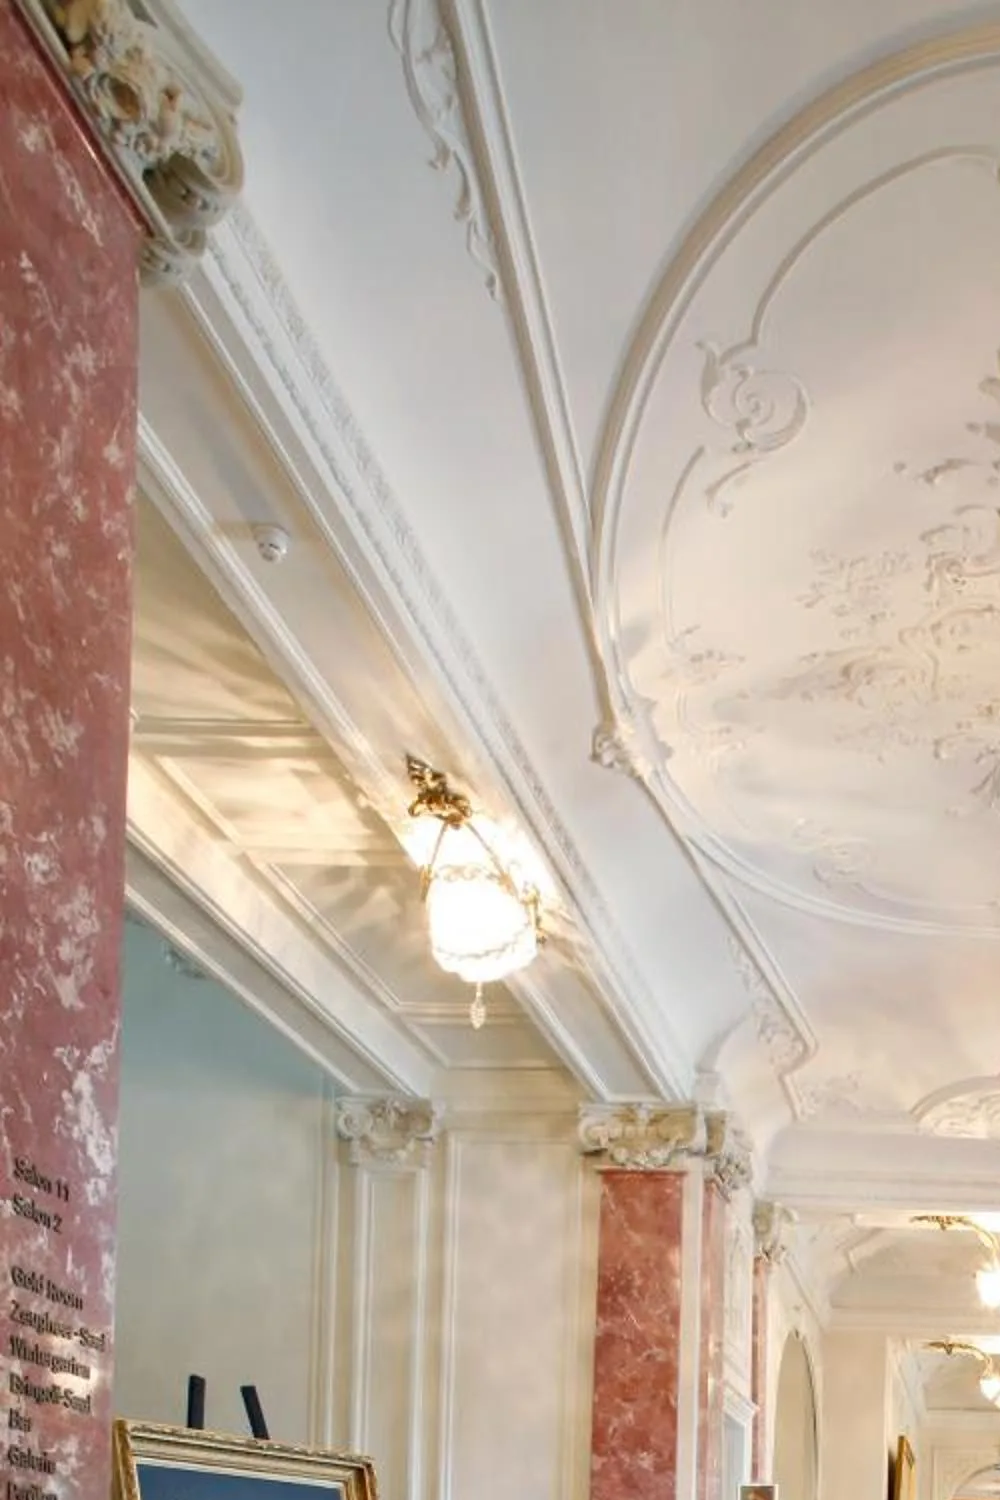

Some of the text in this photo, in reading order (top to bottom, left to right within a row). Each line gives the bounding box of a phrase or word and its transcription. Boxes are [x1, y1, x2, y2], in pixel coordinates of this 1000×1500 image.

[13, 1155, 52, 1194] Salon
[12, 1193, 63, 1235] Salon 2
[9, 1334, 91, 1380] Wintergarten
[7, 1407, 32, 1433] Bar
[7, 1445, 57, 1475] Galerie
